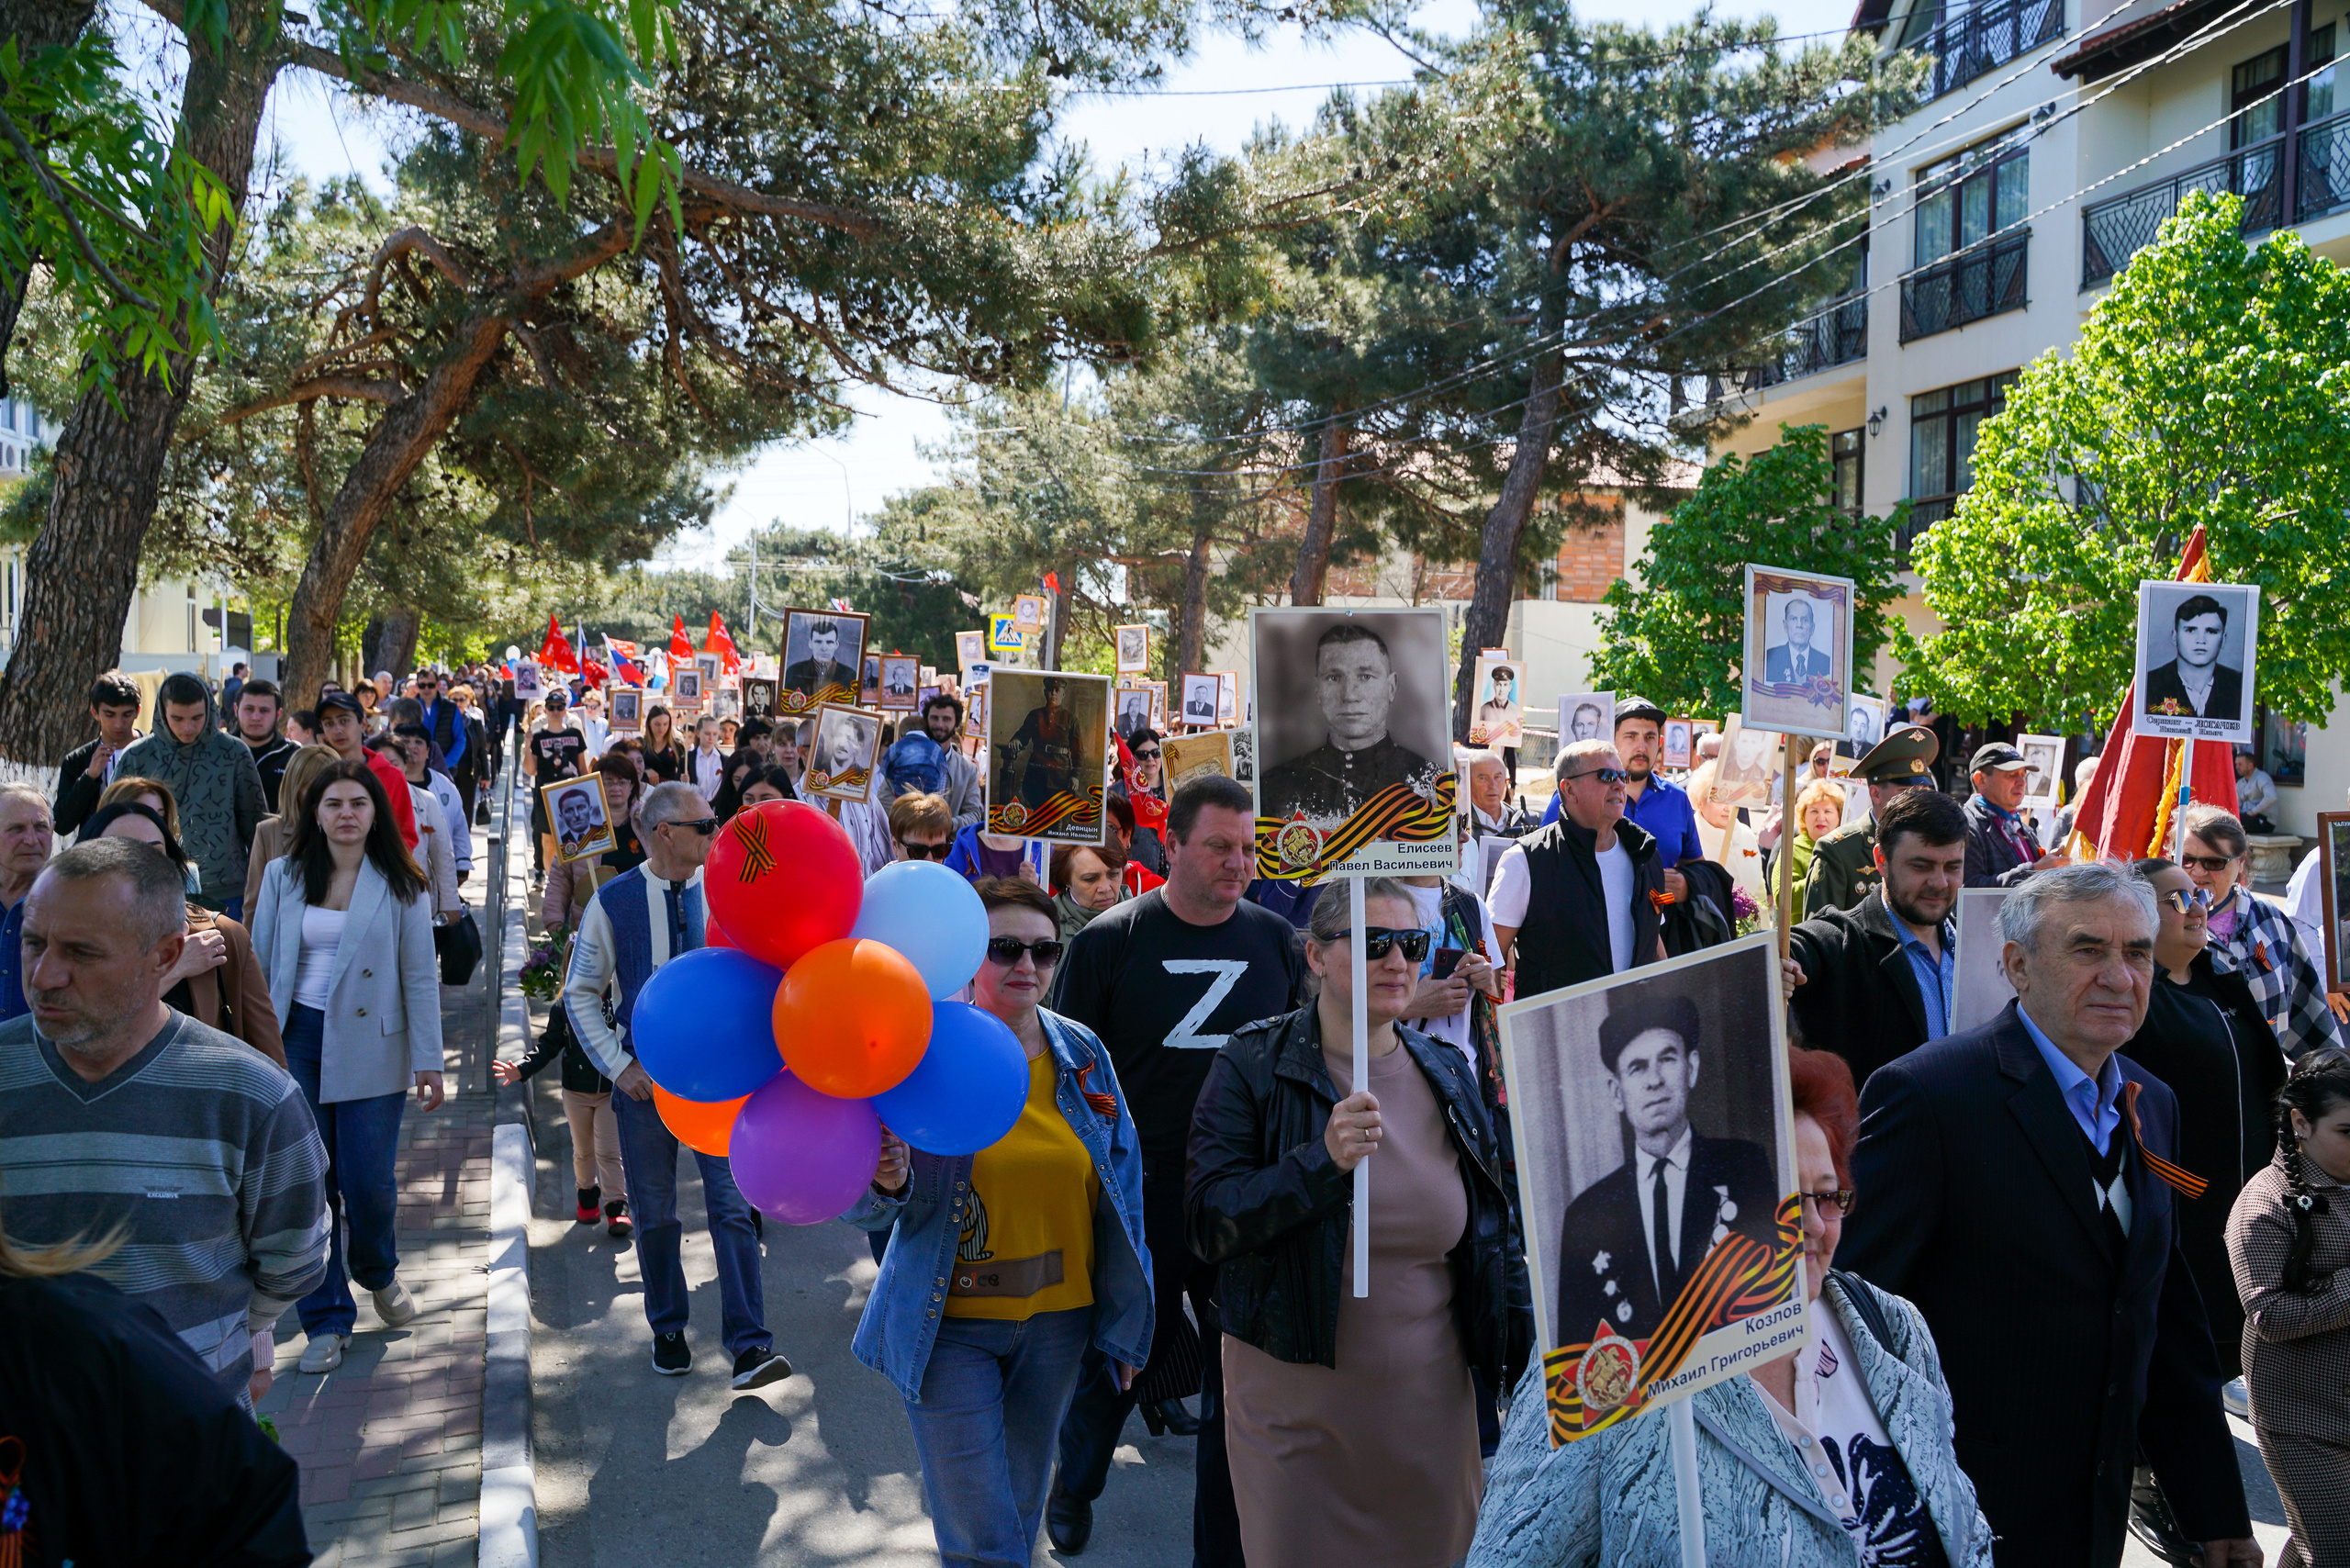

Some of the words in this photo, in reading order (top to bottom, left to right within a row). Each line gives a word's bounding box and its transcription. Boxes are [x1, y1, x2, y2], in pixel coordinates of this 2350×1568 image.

[2195, 720, 2240, 730] ЛОГАЧЕВ
[1066, 823, 1098, 833] Девицын
[1398, 844, 1452, 854] Елисеев
[1329, 860, 1370, 871] Павел
[1374, 859, 1452, 870] Васильевич
[1162, 959, 1248, 1049] Z
[1745, 1302, 1802, 1335] Козлов
[1647, 1365, 1707, 1399] Михаил
[1710, 1325, 1804, 1372] Григорьевич
